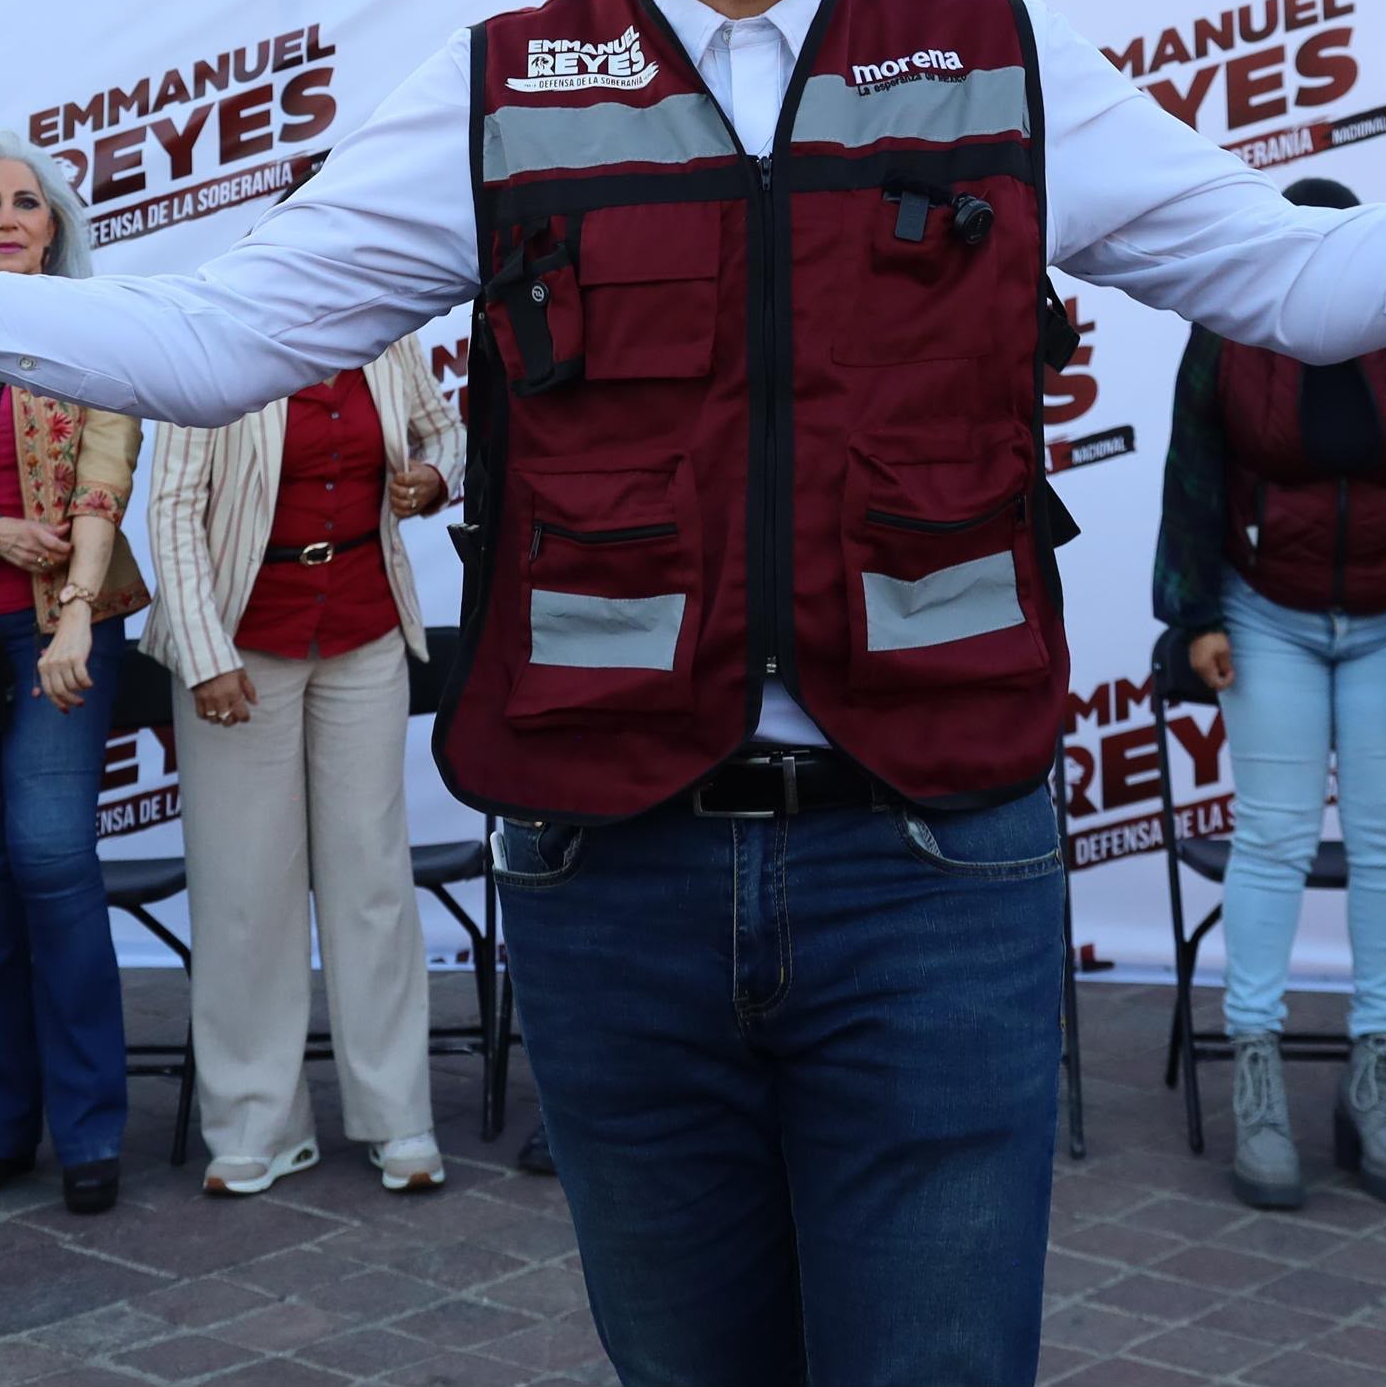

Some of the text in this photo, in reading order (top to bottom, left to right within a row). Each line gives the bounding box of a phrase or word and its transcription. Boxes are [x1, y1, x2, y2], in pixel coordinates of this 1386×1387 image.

[528, 25, 639, 54] EMMANUEL
[527, 41, 645, 78] REYES
[852, 49, 963, 84] morena
[29, 23, 336, 148] EMMANUEL
[539, 79, 574, 89] DEFENSA
[577, 78, 586, 86] DE
[588, 77, 598, 85] LA
[601, 76, 644, 87] SOBERANÍA
[857, 84, 871, 97] La
[1139, 26, 1358, 131] YES
[89, 161, 293, 247] FENSA DE LA SOBERANÍA
[1072, 436, 1126, 464] NACIONAL
[140, 795, 162, 824] DE
[1075, 818, 1162, 865] DEFENSA
[1197, 804, 1223, 834] LA
